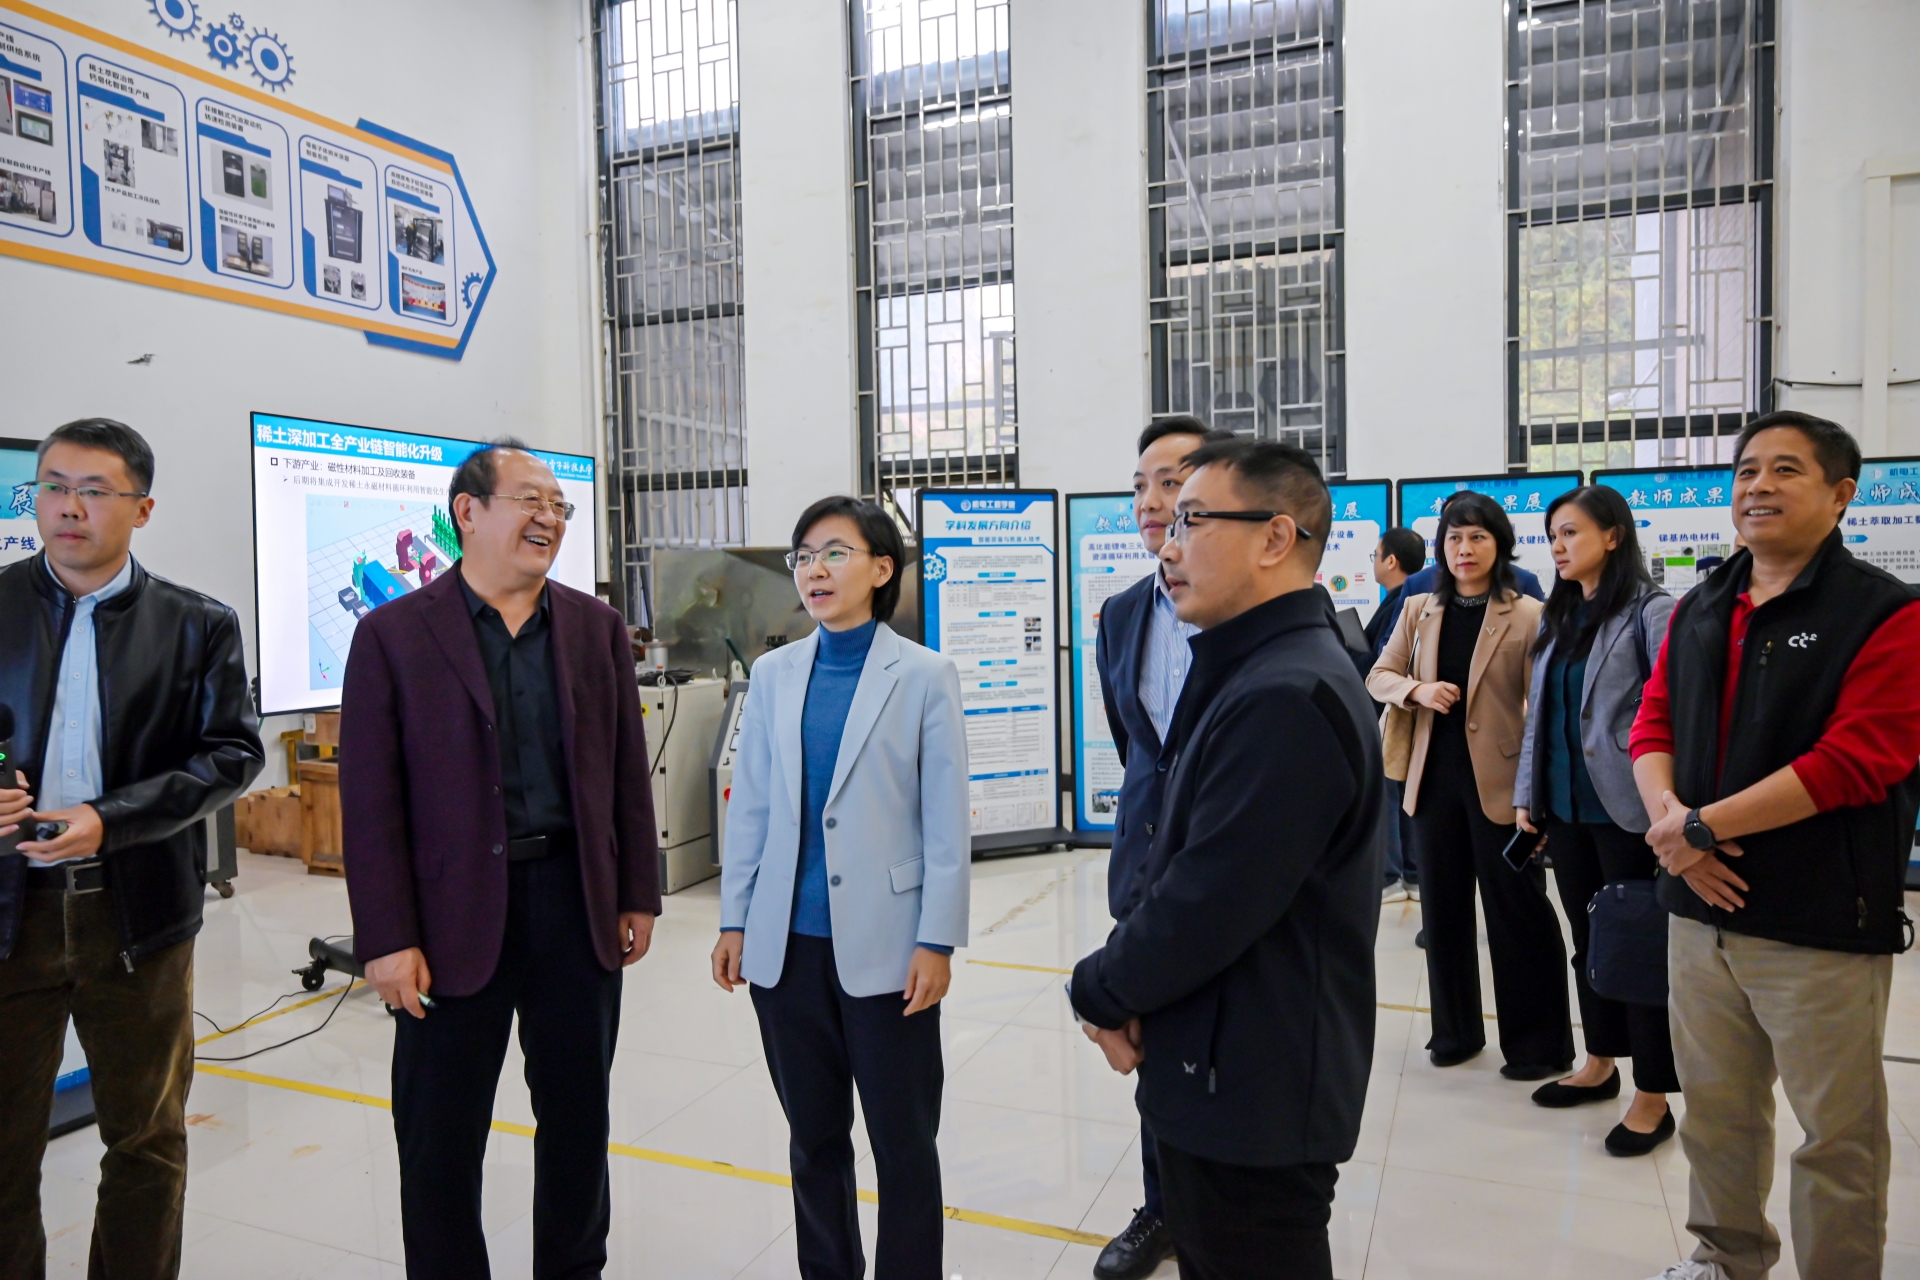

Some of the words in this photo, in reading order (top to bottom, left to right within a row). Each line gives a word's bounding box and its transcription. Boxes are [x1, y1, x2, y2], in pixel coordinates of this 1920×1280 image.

[88, 63, 134, 85] 稀土萃取冶炼
[256, 423, 443, 462] 稀土深加工全产业链智能化升级
[1626, 486, 1732, 508] 教师成果
[945, 520, 1032, 530] 学科发展方向介绍
[0, 536, 36, 551] 产线
[1516, 535, 1550, 545] 关键技
